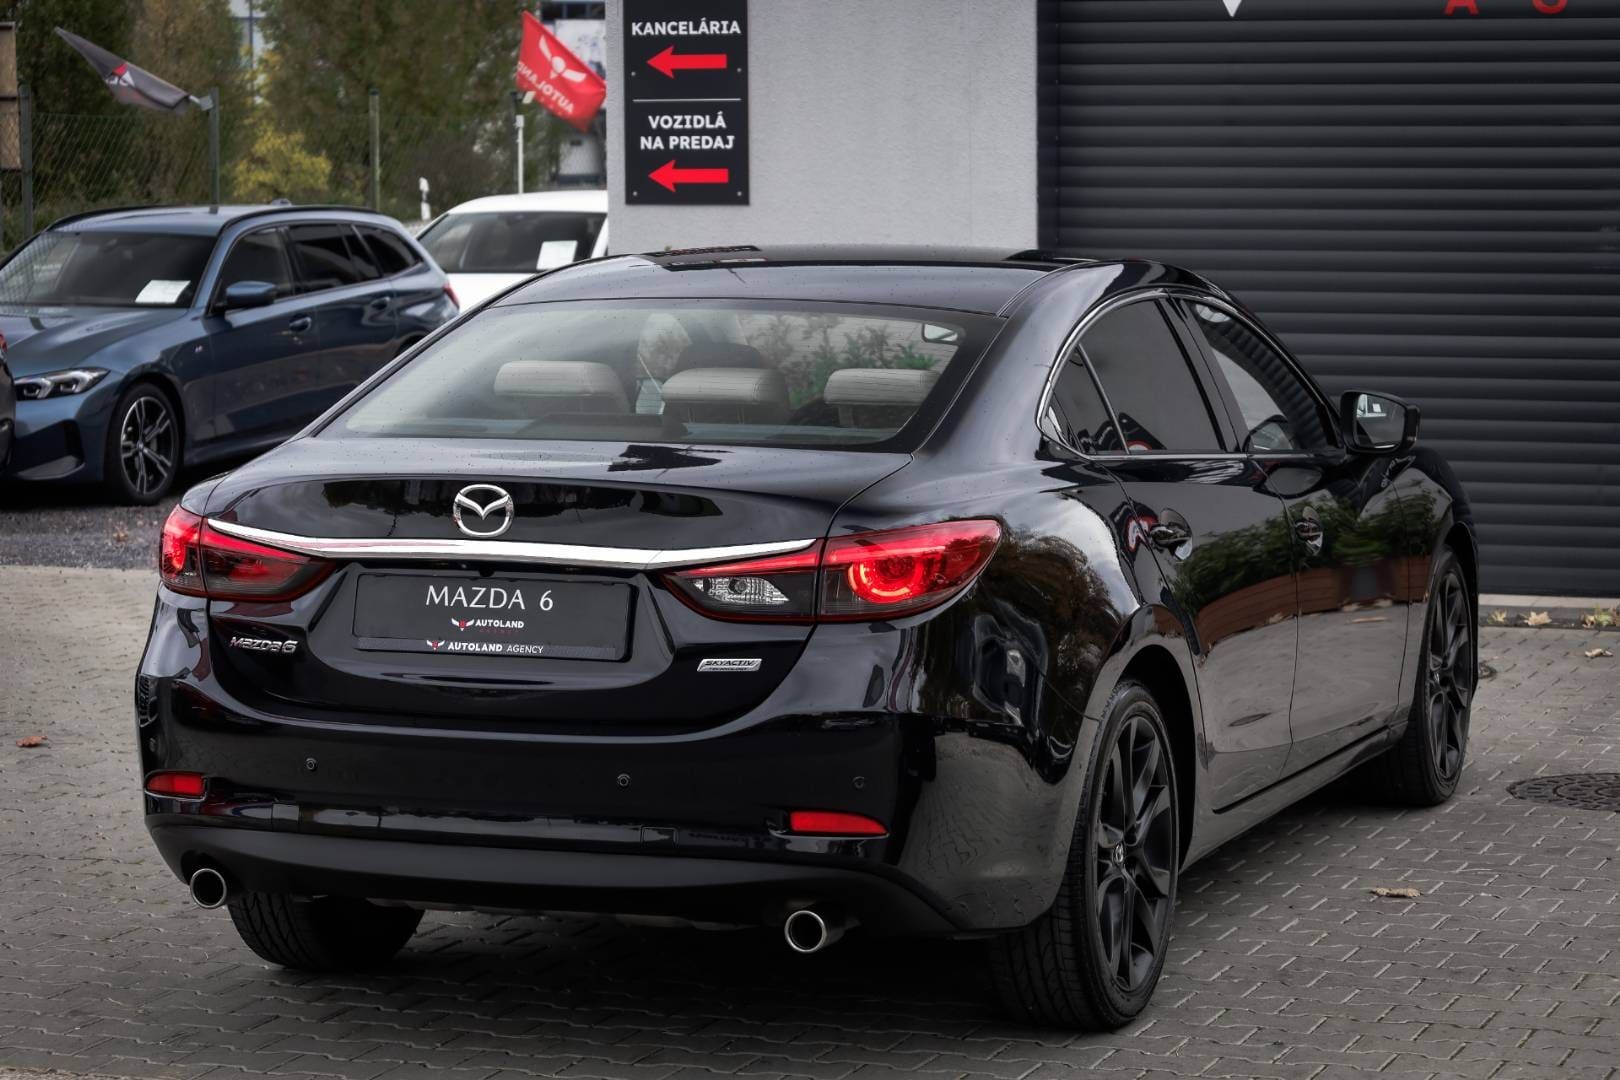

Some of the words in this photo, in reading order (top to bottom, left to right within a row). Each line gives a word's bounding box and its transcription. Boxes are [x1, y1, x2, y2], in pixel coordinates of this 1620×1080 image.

[631, 17, 741, 36] KANCELÁRIA
[648, 111, 727, 129] VOZIDLÁ
[640, 135, 665, 150] NA
[669, 135, 735, 150] PREDAJ
[425, 585, 526, 610] MAZDA
[539, 590, 554, 611] 6
[475, 618, 525, 629] AUTOLAND
[447, 641, 503, 652] AUTOLAND
[506, 644, 544, 654] AGENCY
